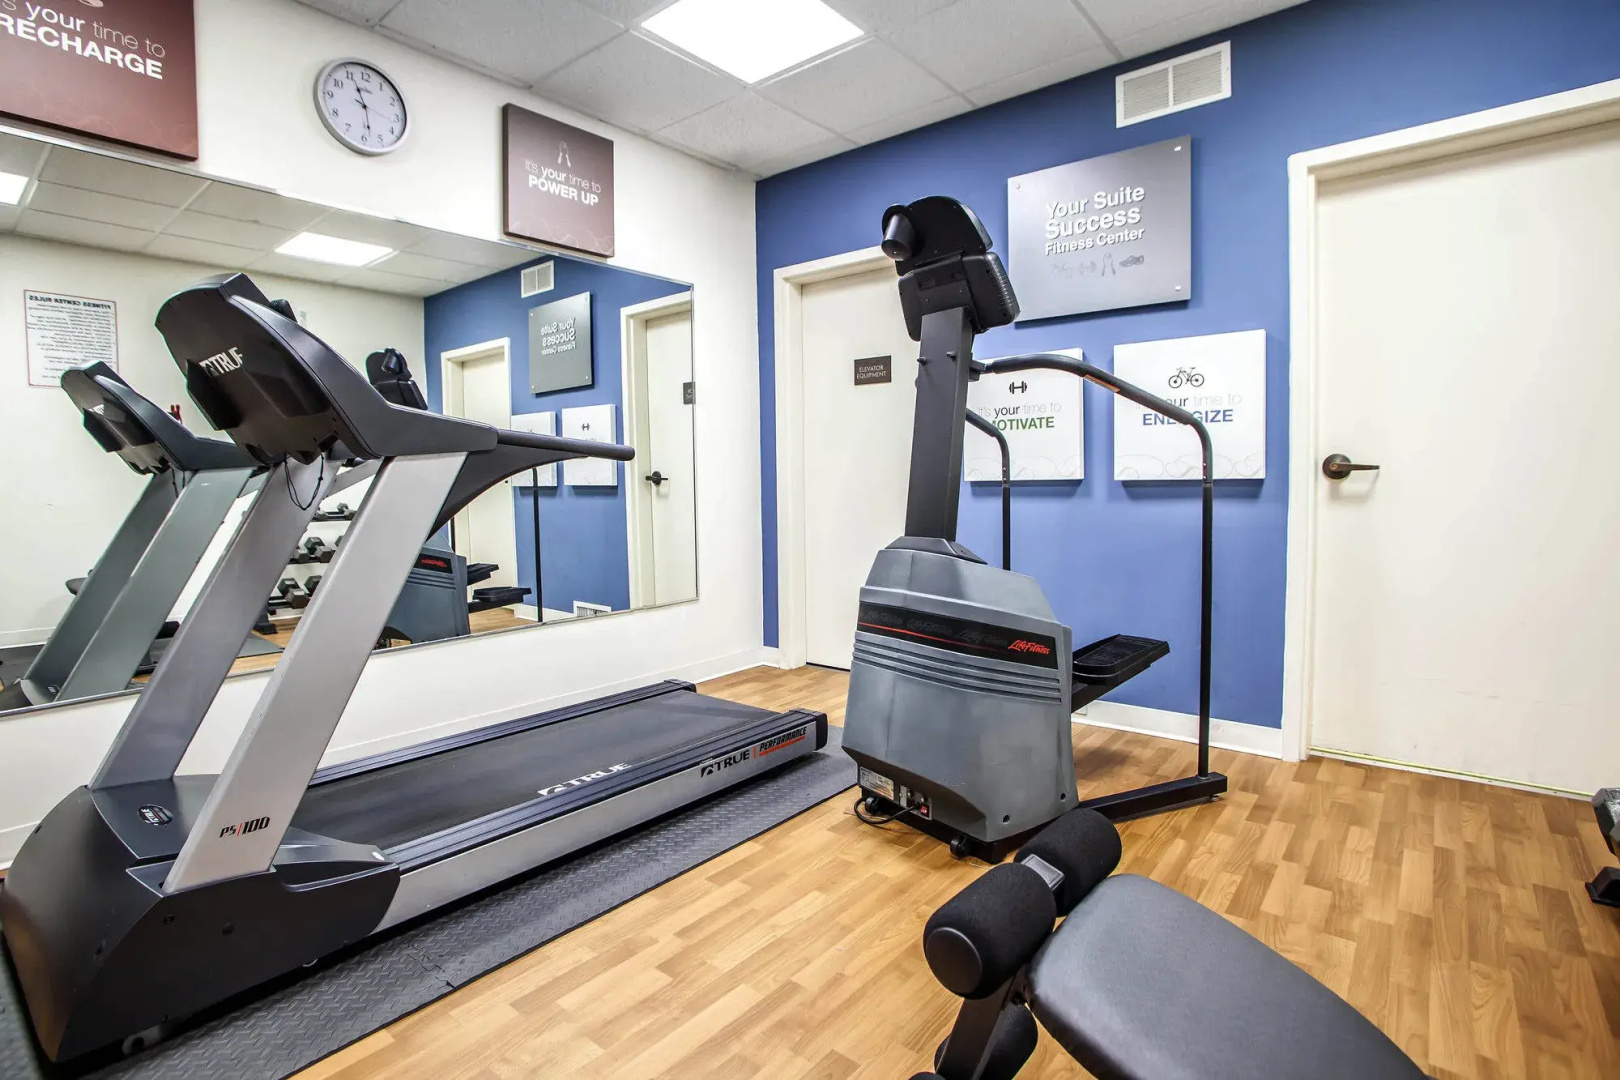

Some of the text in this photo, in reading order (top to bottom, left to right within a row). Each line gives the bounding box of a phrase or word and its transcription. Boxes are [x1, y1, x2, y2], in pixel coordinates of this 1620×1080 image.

[25, 1, 166, 59] your time to
[0, 13, 163, 80] RECHARGE
[345, 70, 354, 81] 11
[361, 71, 371, 83] 12
[333, 78, 344, 89] 10
[379, 82, 383, 91] 1
[326, 90, 334, 98] 9
[389, 96, 396, 107] 2
[332, 108, 339, 117] 8
[393, 113, 400, 123] 3
[345, 122, 352, 132] 7
[388, 126, 395, 135] 4
[361, 133, 368, 142] 6
[377, 134, 383, 144] 5
[525, 159, 601, 193] It's your time to
[528, 174, 599, 206] POWER UP
[1046, 186, 1146, 219] Your Suite
[1045, 206, 1142, 240] Success
[1045, 227, 1145, 256] Fitness Center
[859, 364, 884, 373] ELEVATOR
[856, 370, 887, 380] EQUIPMENT
[1193, 394, 1223, 405] time
[1228, 392, 1242, 405] to
[993, 405, 1020, 419] your
[1023, 402, 1047, 414] time
[1050, 402, 1062, 413] to
[1142, 408, 1234, 426] ENGIZE
[714, 726, 807, 772] TRUE PERFORMANCE
[564, 762, 632, 786] TRUE
